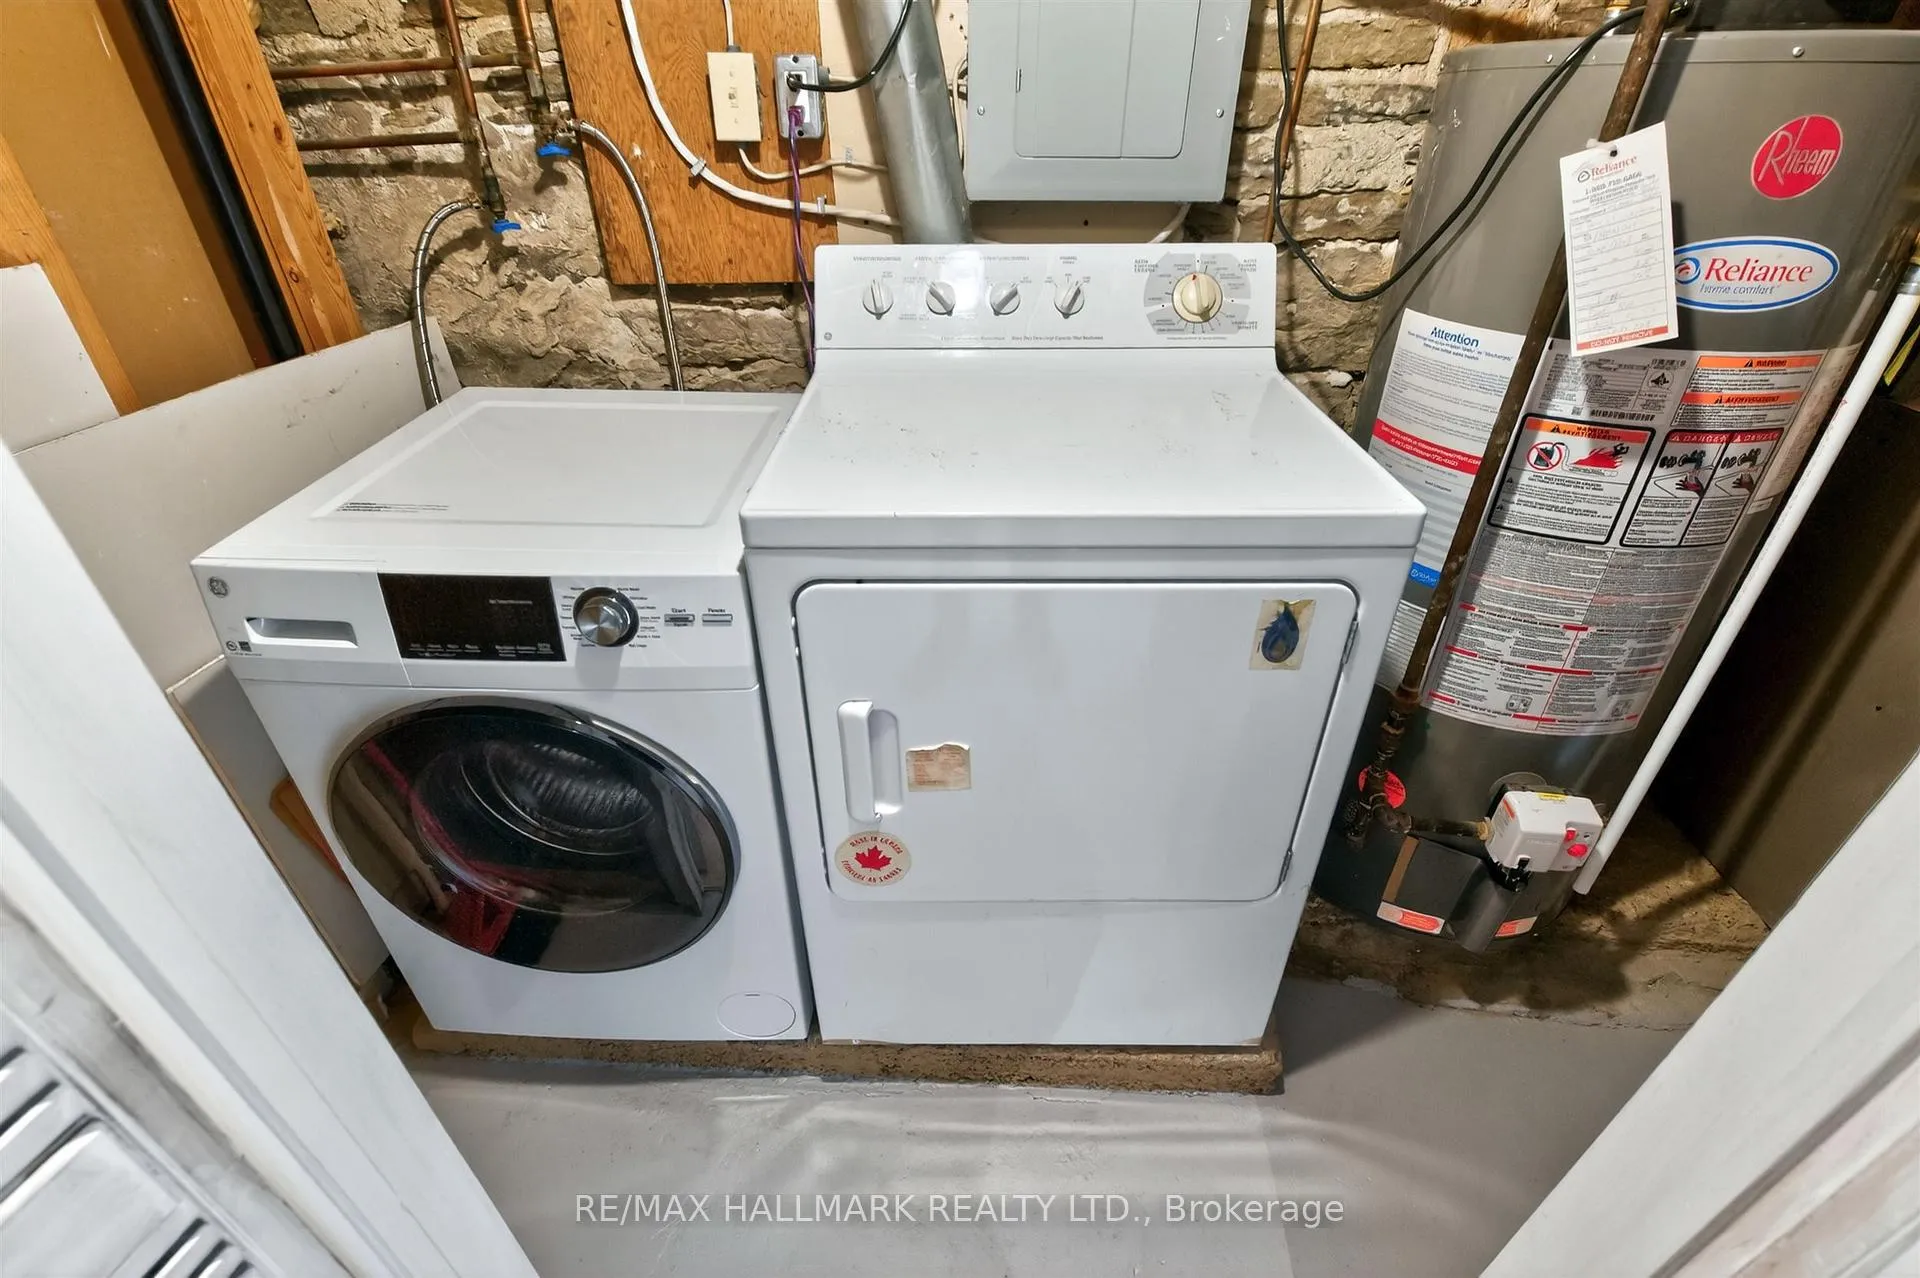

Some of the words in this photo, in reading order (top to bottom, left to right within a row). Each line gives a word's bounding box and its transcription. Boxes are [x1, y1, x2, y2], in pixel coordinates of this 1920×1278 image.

[1757, 117, 1836, 186] Rheem
[1591, 155, 1637, 177] Reliance
[1704, 257, 1813, 283] Reliance
[1700, 283, 1732, 294] home
[1732, 284, 1775, 295] comfort
[1430, 326, 1480, 349] Attention
